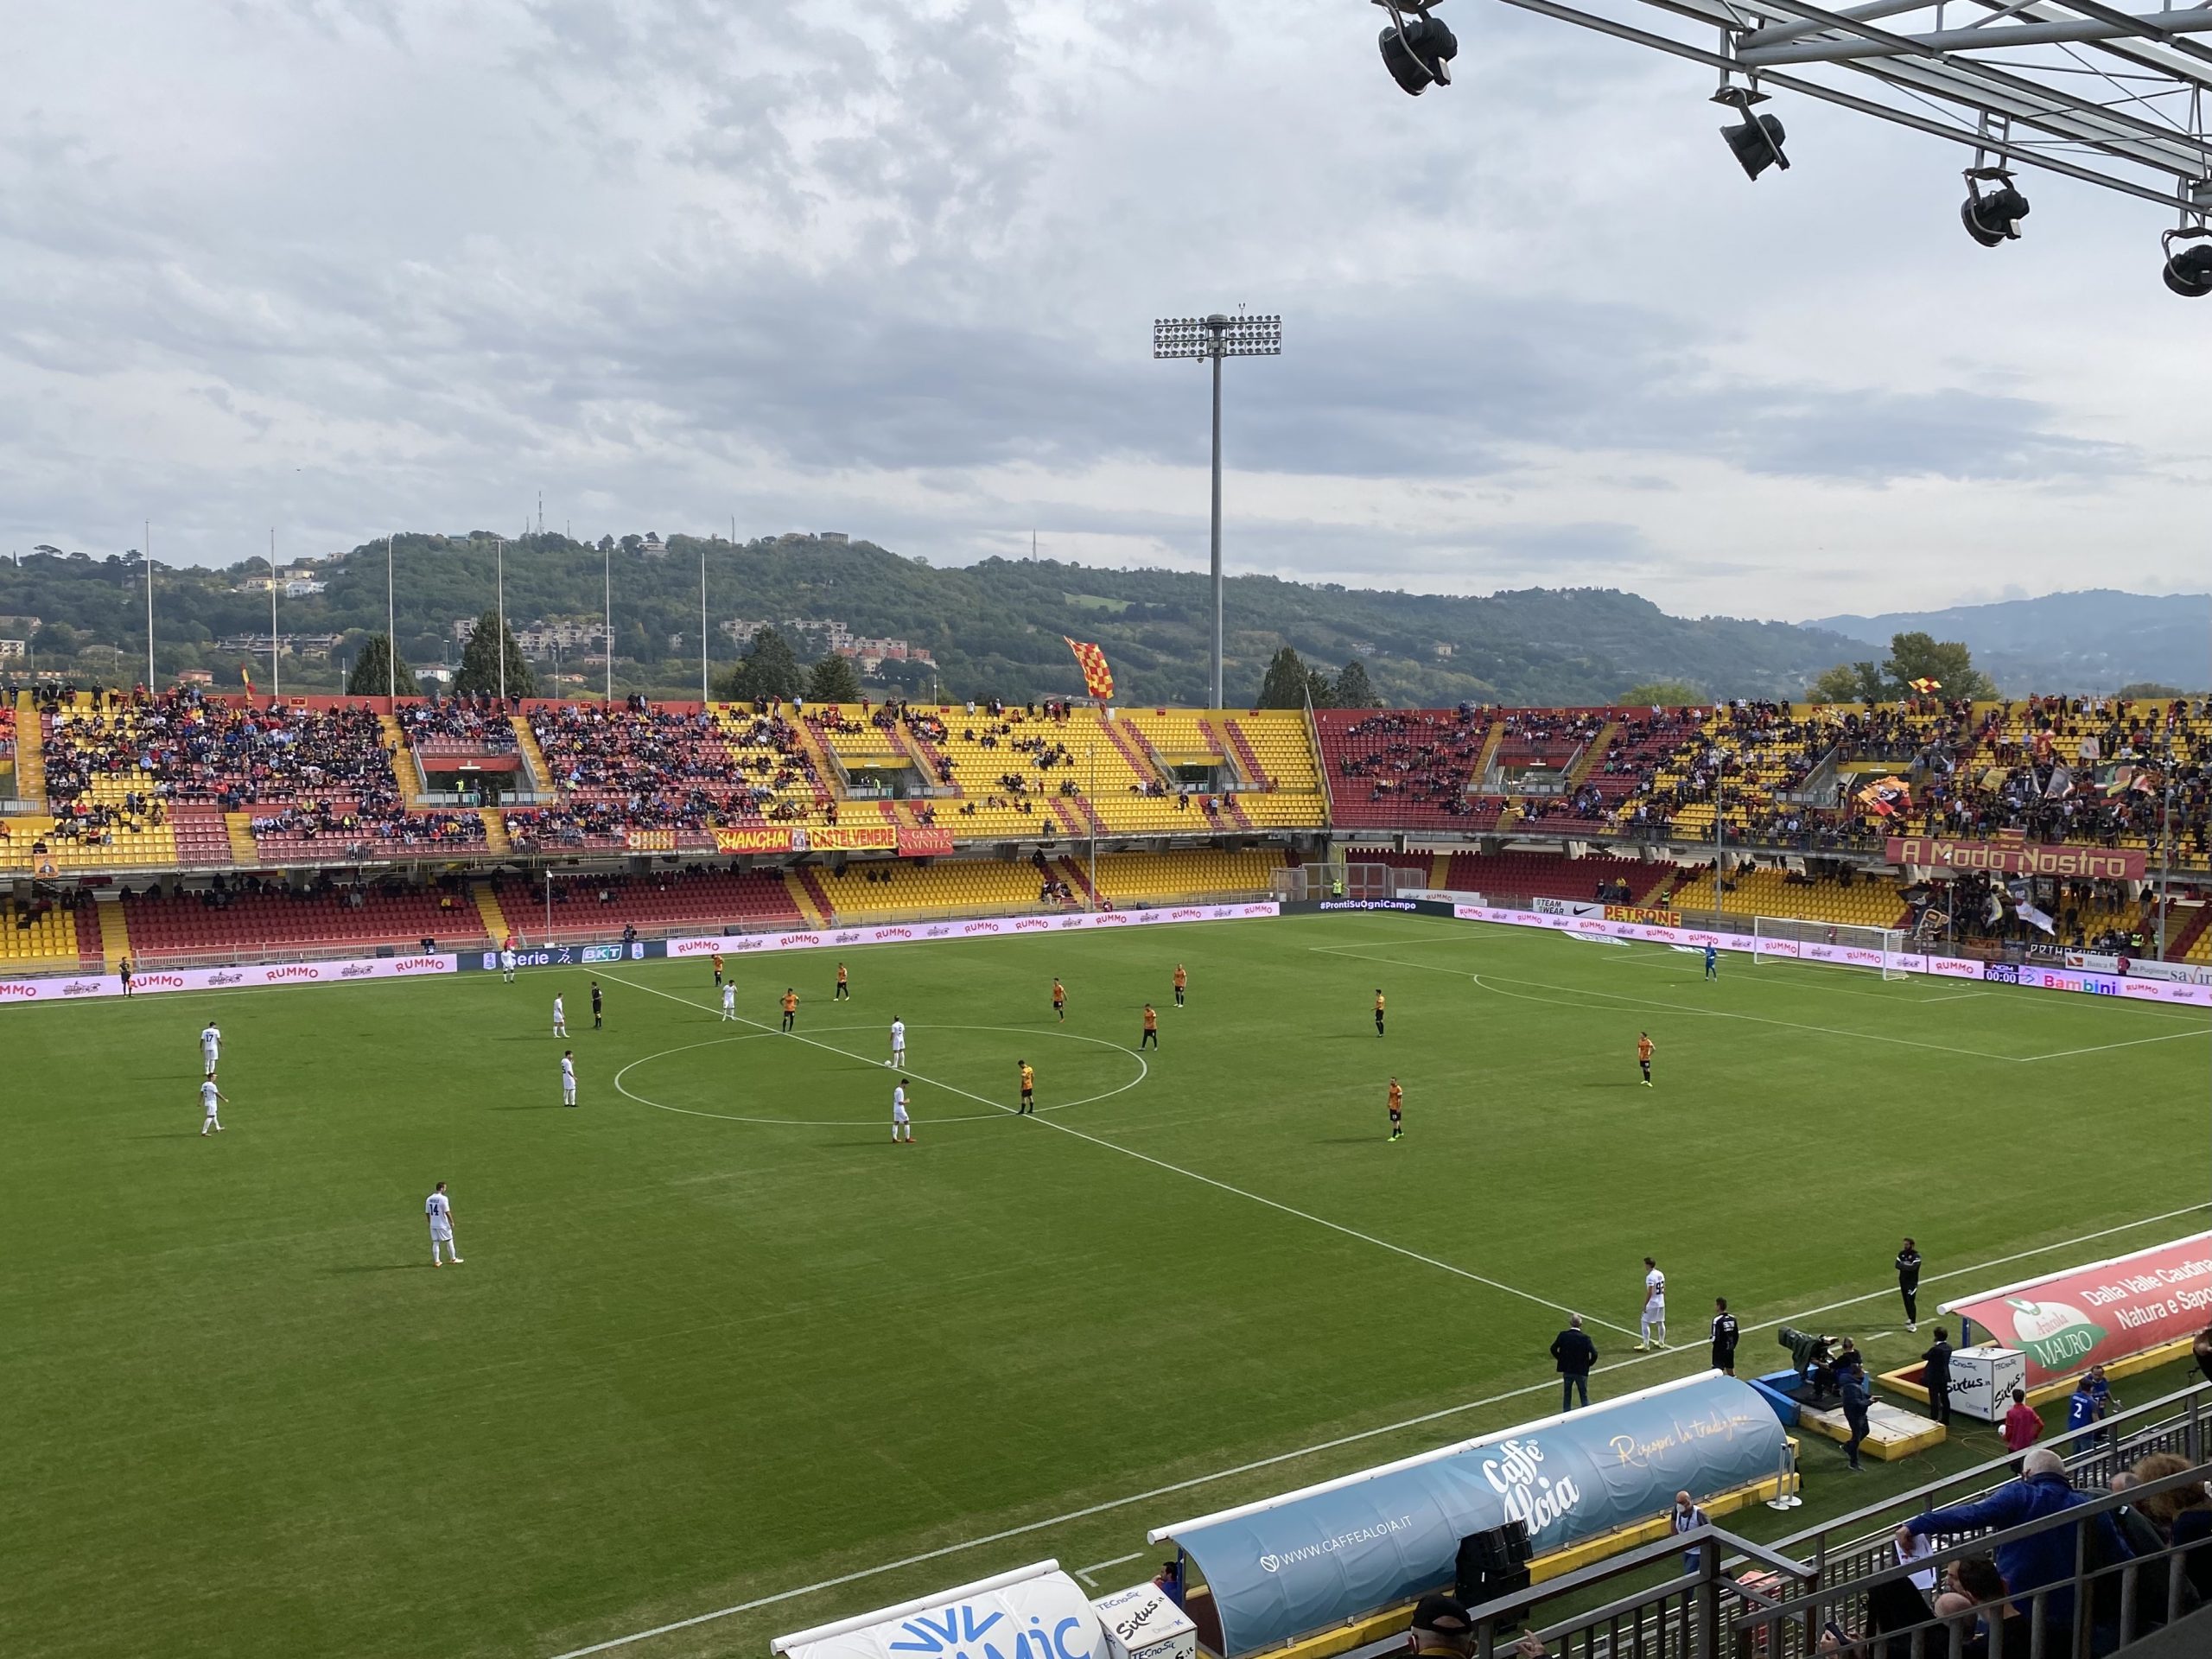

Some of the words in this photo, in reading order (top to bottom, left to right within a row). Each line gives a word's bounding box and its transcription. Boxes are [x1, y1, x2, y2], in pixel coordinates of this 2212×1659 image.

[717, 830, 791, 850] SHANGHAI
[811, 828, 894, 849] CASTELVENERE
[912, 830, 939, 840] GENS
[899, 839, 952, 849] SAMNITES
[1901, 840, 1921, 864] A
[1931, 842, 2005, 869] Modo
[2018, 846, 2126, 877] Nostro
[1426, 893, 1452, 902] RUMMO
[1244, 905, 1273, 915] RUMMO
[1320, 899, 1416, 911] #ProntiSuOgniCampo
[1096, 913, 1127, 925] RUMMO
[1173, 909, 1202, 920] RUMMO
[1517, 914, 1542, 925] RUMMO
[1604, 906, 1681, 928] PETRONE
[964, 922, 999, 934] RUMMO
[1015, 919, 1049, 931] RUMMO
[1580, 920, 1606, 931] RUMMO
[875, 928, 912, 940] RUMMO
[1646, 929, 1675, 940] RUMMO
[1688, 934, 1719, 944] RUMMO
[677, 941, 720, 953] RUMMO
[780, 935, 819, 947] RUMMO
[585, 947, 620, 960] BKT
[1764, 942, 1797, 954] RUMMO
[1847, 951, 1881, 963] RUMMO
[395, 959, 445, 973] RUMMO
[1936, 961, 1974, 975] RUMMO
[266, 967, 319, 982] RUMMO
[1986, 970, 2017, 983] 00:00
[130, 976, 184, 989] RUMMO
[2044, 975, 2116, 995] Bambini
[0, 984, 36, 997] MMO
[2126, 984, 2158, 995] RUMMO
[206, 1033, 213, 1043] 17
[429, 1204, 439, 1216] 14
[2079, 1285, 2129, 1306] Dalla
[2117, 1274, 2164, 1294] Valle
[2155, 1259, 2212, 1284] Caudina
[2113, 1302, 2168, 1331] Natura
[2166, 1299, 2179, 1314] e
[2176, 1285, 2212, 1311] Sapo
[2033, 1330, 2093, 1369] MAURO
[2073, 1402, 2082, 1419] 2
[1673, 1420, 1694, 1445] la
[1504, 1475, 1580, 1536] Aloia
[1280, 1515, 1413, 1566] WWW.CAFFEALOIA.IT
